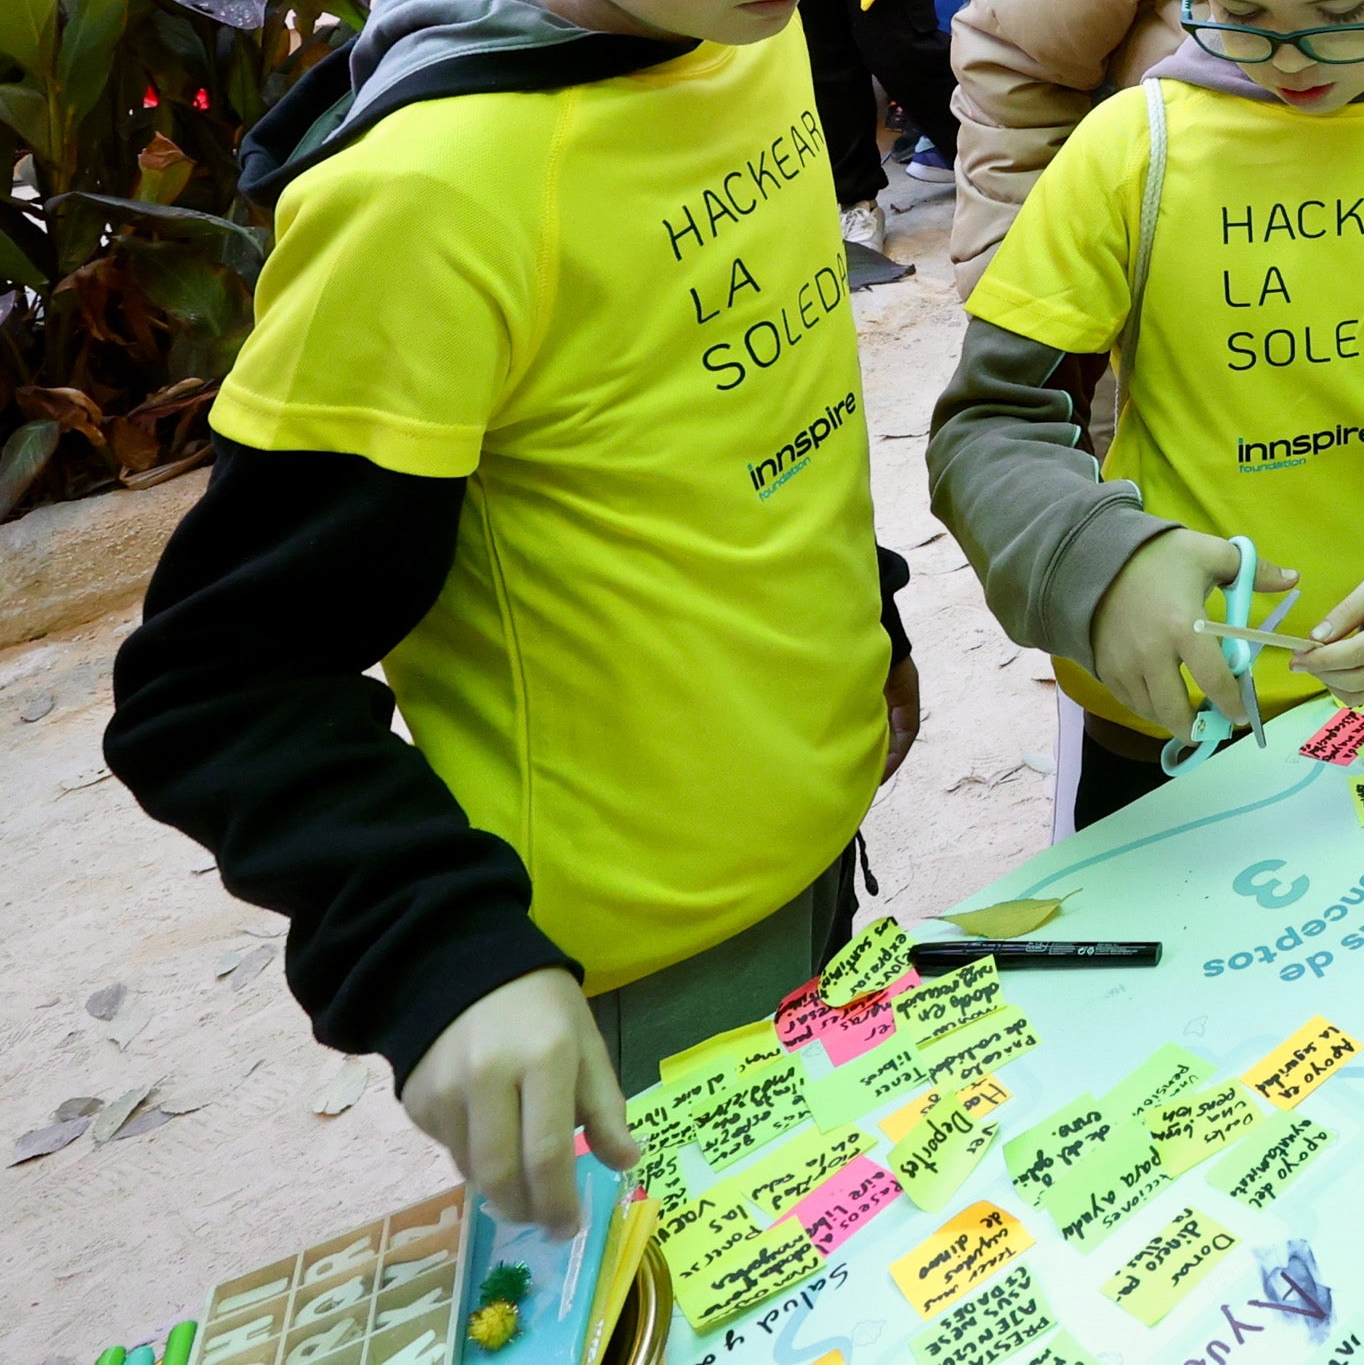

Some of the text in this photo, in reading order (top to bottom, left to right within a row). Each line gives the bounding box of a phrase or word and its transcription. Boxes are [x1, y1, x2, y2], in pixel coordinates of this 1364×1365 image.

[662, 110, 825, 261] HACKEAR
[689, 258, 761, 325] LA
[1223, 266, 1291, 308] LA
[701, 252, 849, 391] SOLEDA
[748, 391, 857, 492] innspire
[1232, 859, 1310, 909] 3
[1280, 951, 1333, 981] de
